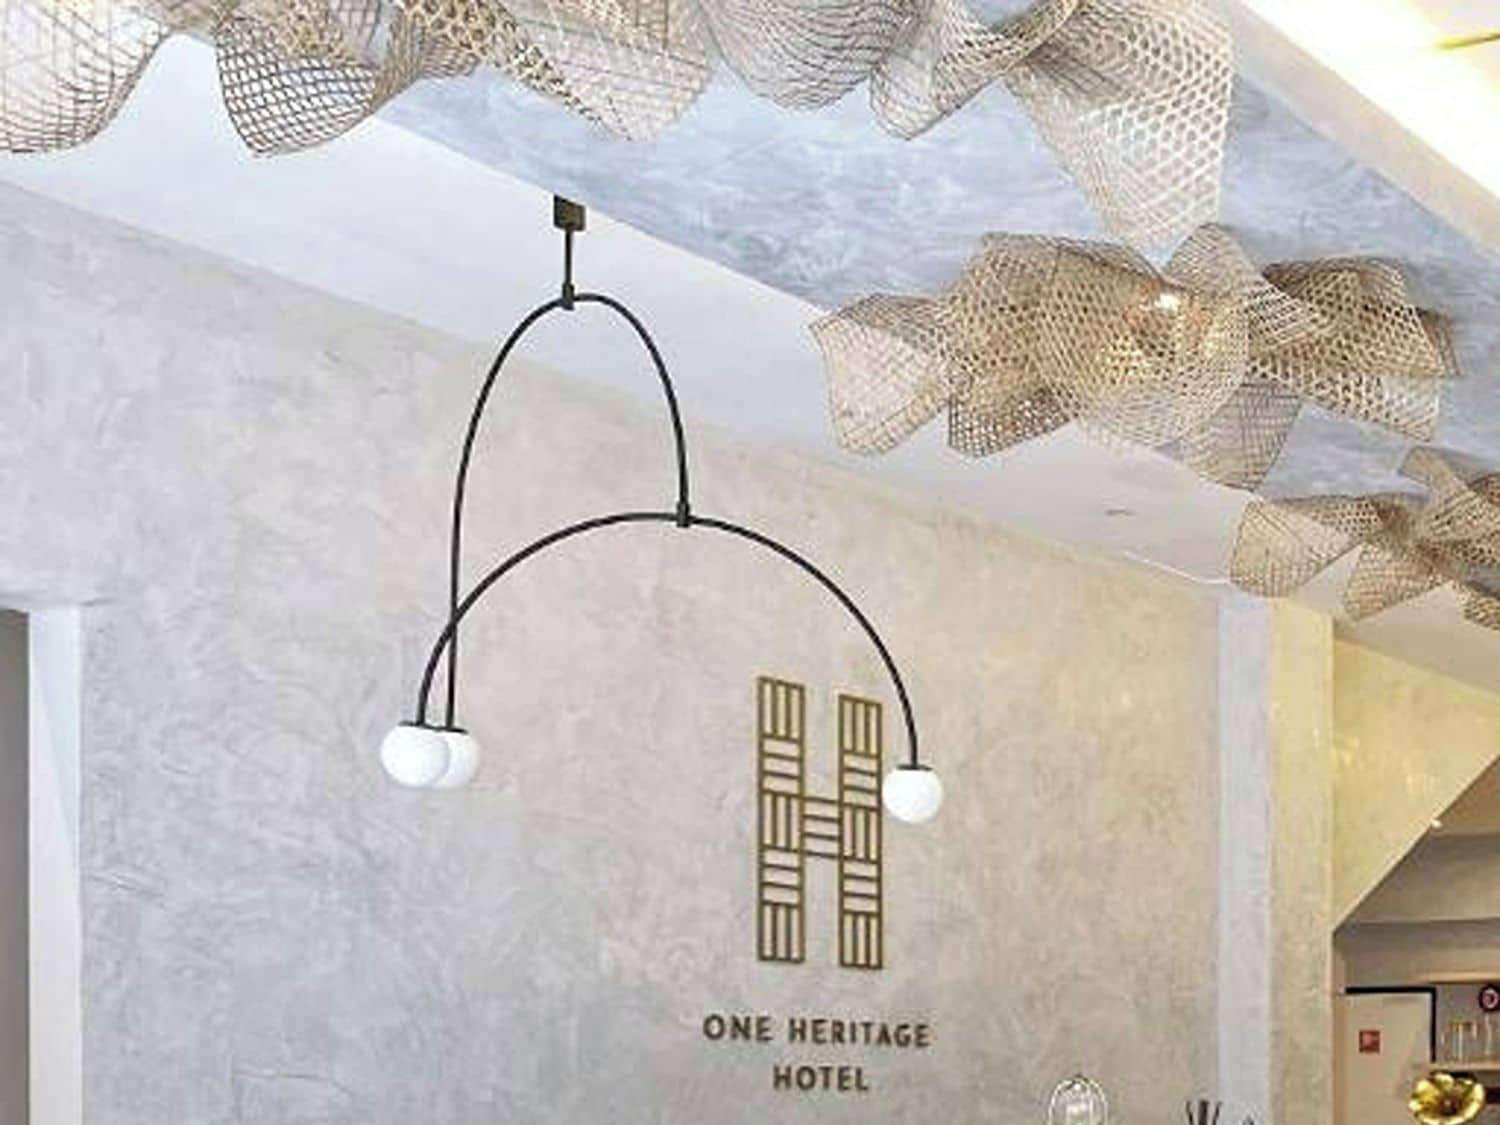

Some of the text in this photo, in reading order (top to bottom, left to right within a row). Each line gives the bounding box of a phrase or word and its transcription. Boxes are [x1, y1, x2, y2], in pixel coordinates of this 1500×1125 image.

[703, 1014, 931, 1048] ONE HERITAGE
[773, 1065, 869, 1091] HOTEL
